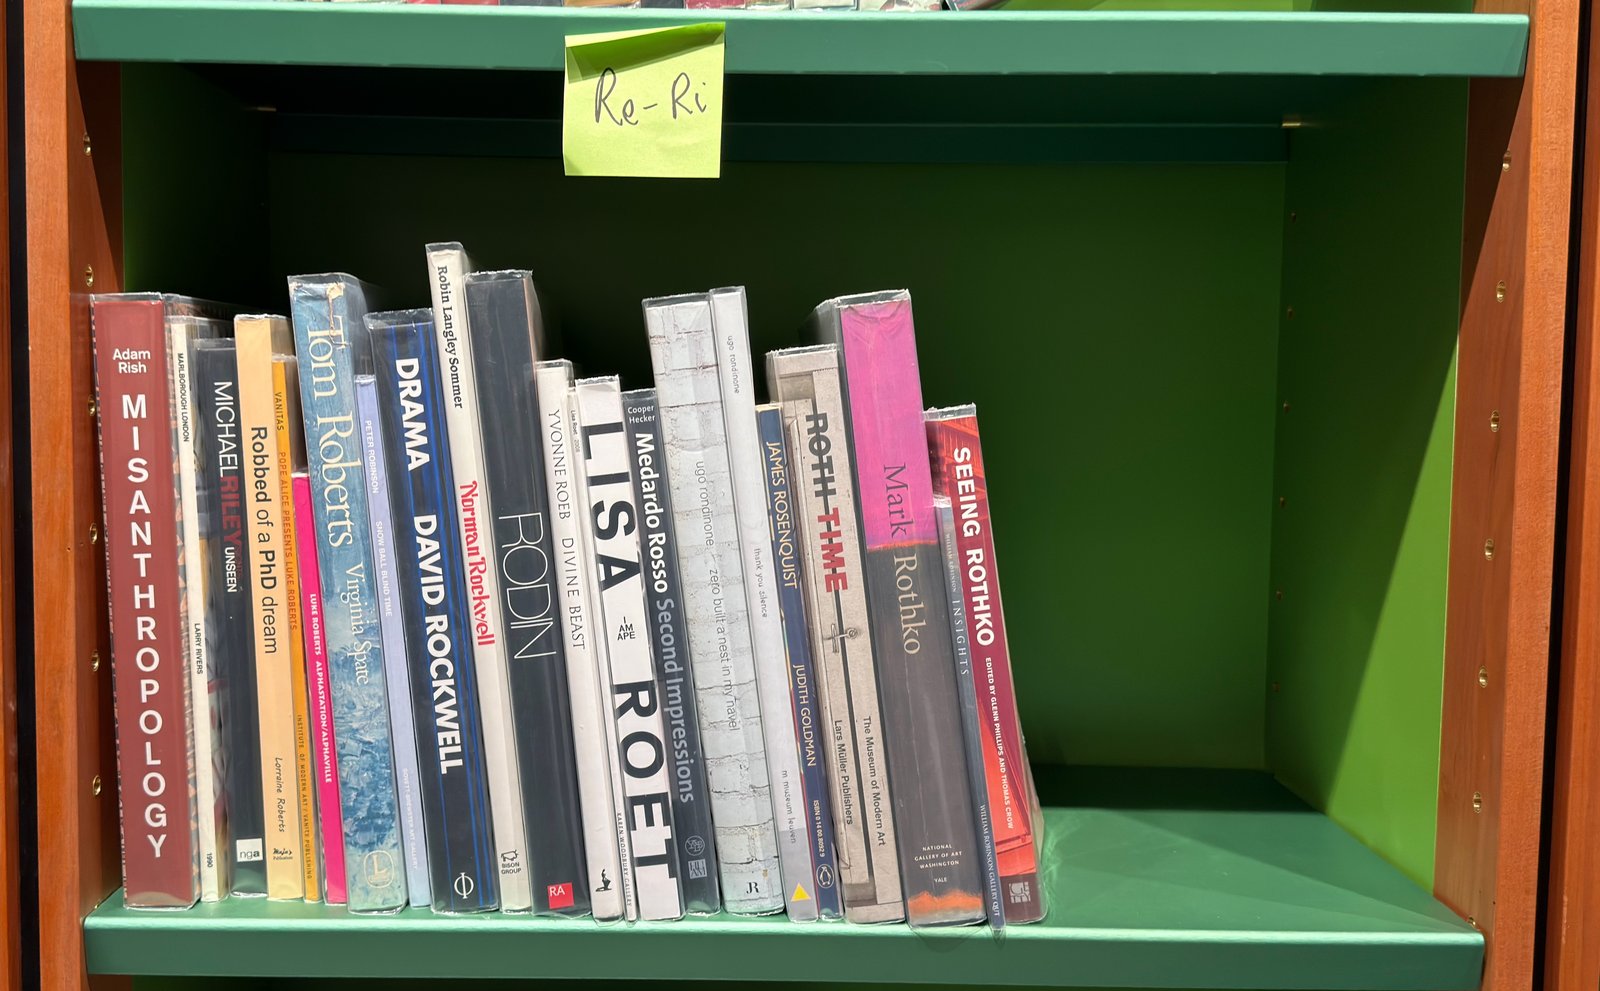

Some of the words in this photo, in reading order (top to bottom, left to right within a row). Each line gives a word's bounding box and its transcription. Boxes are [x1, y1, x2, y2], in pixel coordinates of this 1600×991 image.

[437, 264, 451, 304] Robin
[443, 306, 457, 355] Langley
[727, 336, 735, 353] ugo
[113, 348, 151, 361] Adam
[118, 361, 147, 374] Rish
[307, 315, 346, 400] Tom
[178, 353, 188, 410] MARLBOROUGH
[449, 358, 463, 409] Sommer
[730, 353, 740, 394] rondinone
[274, 392, 285, 431] VANITAS
[395, 357, 431, 471] DRAMA
[627, 404, 655, 414] Cooper
[629, 414, 656, 424] Hecker
[181, 412, 190, 442] LONDON
[365, 420, 374, 449] PETER
[548, 409, 566, 477] YVONNE
[251, 426, 272, 502] Robbed
[279, 452, 288, 476] POPE
[367, 450, 378, 494] ROBINSON
[694, 461, 706, 483] ugo
[766, 441, 786, 486] JAMES
[805, 413, 837, 499] ROTH
[280, 479, 290, 506] ALICE
[317, 411, 362, 547] Roberts
[635, 432, 664, 529] Medardo
[954, 447, 981, 538] SEEING
[555, 481, 571, 520] ROEB
[581, 421, 641, 592] LISA
[698, 485, 715, 546] rondinone
[883, 463, 914, 539] Mark
[256, 510, 274, 527] of
[282, 511, 293, 557] PRESENTS
[376, 521, 384, 546] SNOW
[460, 480, 480, 557] Norman
[258, 532, 270, 543] a
[775, 490, 798, 590] ROSENQUIST
[817, 507, 848, 593] TIME
[224, 547, 238, 592] UNSEEN
[259, 550, 277, 589] PhD
[285, 561, 295, 585] LUKE
[378, 547, 387, 569] BALL
[413, 514, 445, 606] DAVID
[561, 537, 579, 597] DIVINE
[648, 532, 668, 594] Rosso
[381, 570, 390, 596] BLIND
[499, 512, 557, 659] RODIN
[709, 569, 720, 595] zero
[756, 572, 765, 589] you
[966, 548, 995, 647] ROTHKO
[288, 590, 298, 630] ROBERTS
[310, 594, 319, 616] LUKE
[340, 561, 367, 637] Virginia
[385, 597, 393, 617] TIME
[468, 557, 495, 646] Rockwell
[713, 598, 726, 624] built
[759, 590, 768, 618] silence
[894, 553, 927, 655] Rothko
[121, 394, 169, 858] MISANTHROPOLOGY
[194, 623, 202, 648] LARRY
[262, 597, 278, 654] dream
[312, 619, 322, 656] ROBERTS
[569, 606, 585, 649] BEAST
[617, 631, 636, 640] APE
[619, 623, 634, 632] AM
[656, 598, 683, 674] Second
[718, 627, 725, 635] a
[952, 600, 969, 676] INSIGHTS
[195, 649, 203, 675] RIVERS
[347, 643, 371, 685] Spate
[719, 641, 730, 664] nest
[722, 665, 732, 676] in
[792, 664, 809, 703] JUDITH
[985, 657, 994, 684] EDITED
[425, 615, 464, 774] ROCKWELL
[722, 679, 734, 697] my
[989, 685, 995, 697] BY
[315, 661, 332, 783] ALPHASTATION/ALPHAVILLE
[727, 700, 741, 731] navel
[864, 716, 872, 734] The
[990, 697, 1000, 722] GLENN
[297, 715, 305, 748] INSTITUTE
[664, 677, 695, 803] Impressions
[800, 707, 817, 767] GOLDMAN
[834, 720, 843, 741] Lars
[994, 722, 1004, 757] PHILLIPS
[299, 753, 305, 761] OF
[781, 770, 788, 778] m
[837, 743, 848, 774] Müller
[866, 737, 877, 778] Museum
[998, 757, 1006, 773] AND
[275, 757, 283, 793] Lorraine
[614, 680, 677, 879] ROET
[870, 781, 880, 790] of
[1001, 774, 1011, 806] THOMAS
[782, 780, 793, 815] museum
[841, 776, 854, 825] Publishers
[872, 792, 883, 829] Modern
[787, 816, 797, 844] leuven
[980, 804, 990, 835] WILLIAM
[1005, 807, 1014, 829] CROW
[240, 848, 261, 861] nga
[877, 831, 886, 846] Art
[922, 844, 952, 852] NATIONAL
[983, 836, 995, 870] ROBINSON
[305, 839, 313, 880] PUBLISHING
[501, 867, 522, 875] GROUP
[619, 837, 629, 876] WOODBURY
[624, 878, 632, 907] GALLERY
[914, 853, 939, 862] GALLERY
[949, 850, 963, 858] ART
[919, 859, 960, 869] WASHINGTON
[549, 885, 566, 897] RA
[988, 872, 998, 900] GALLERY
[992, 901, 1000, 917] QUT
